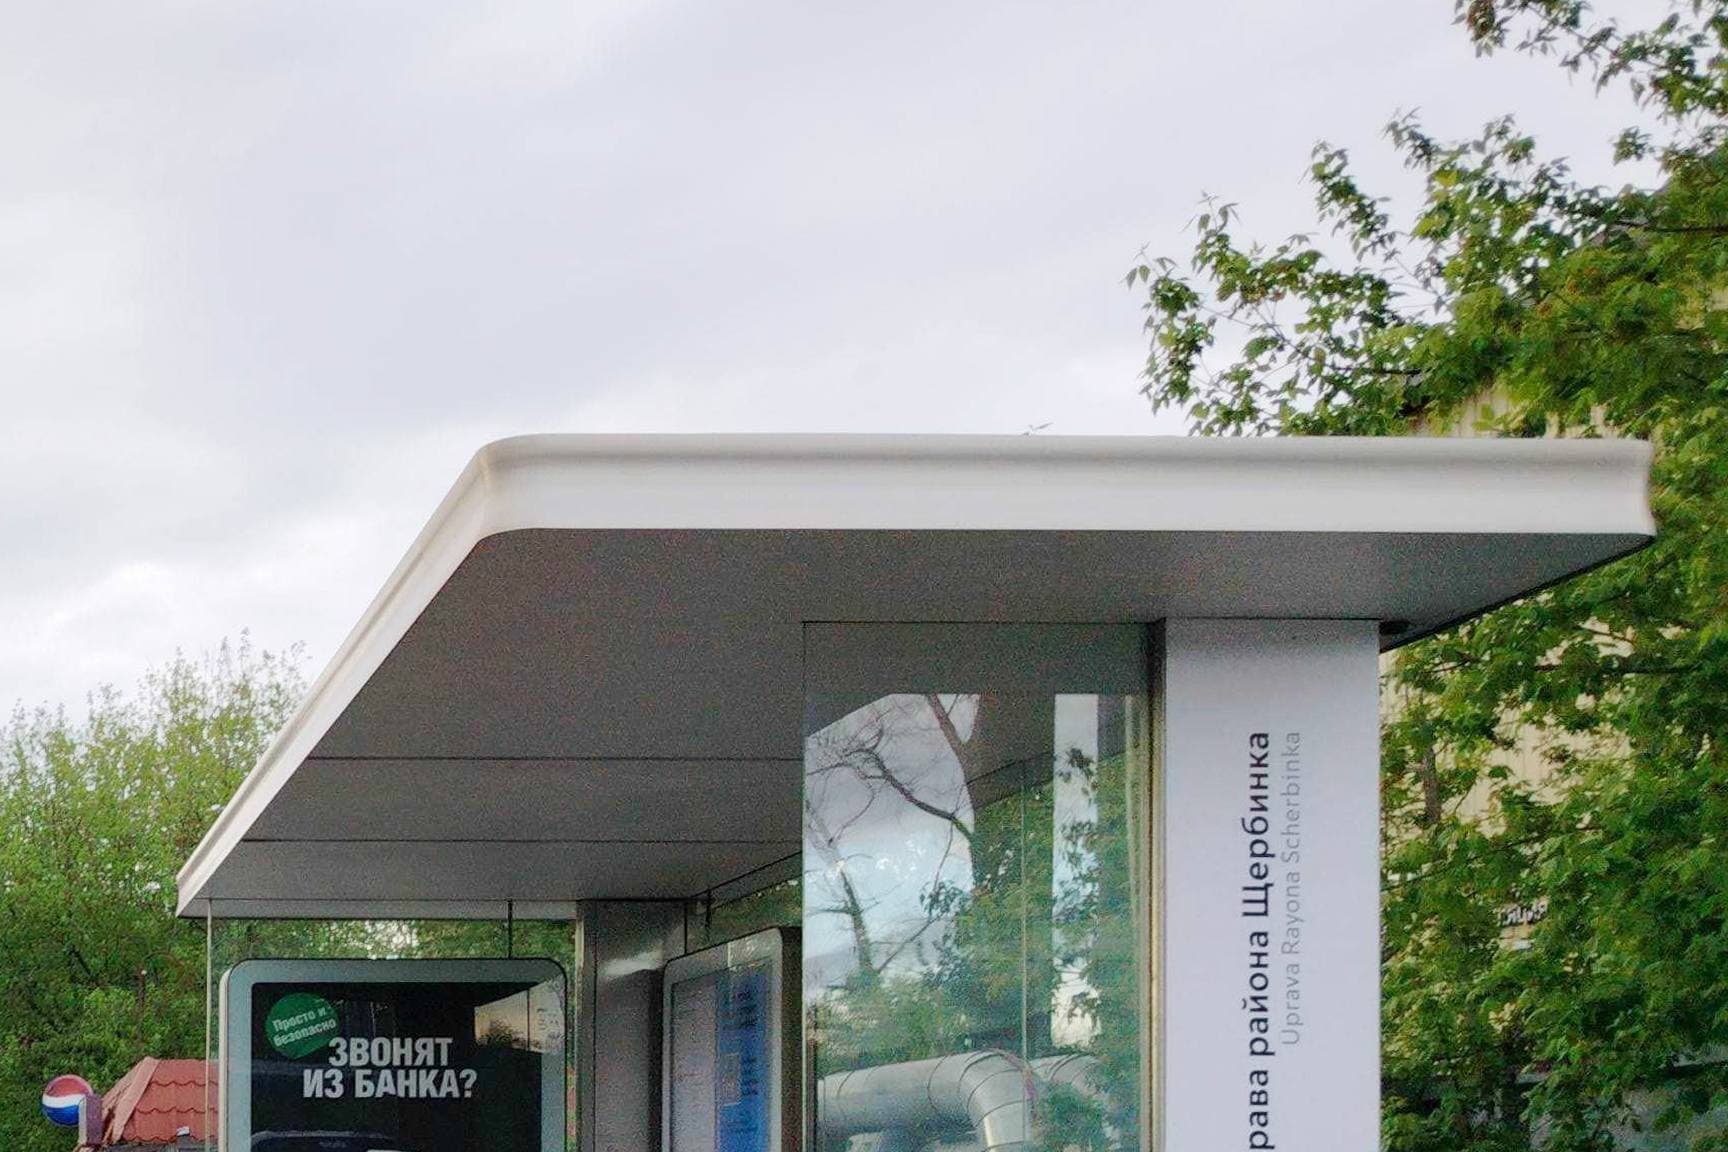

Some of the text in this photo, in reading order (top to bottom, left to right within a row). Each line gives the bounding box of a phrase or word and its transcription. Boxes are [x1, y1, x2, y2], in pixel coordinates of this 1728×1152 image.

[1241, 731, 1276, 917] Щербинка
[1280, 731, 1305, 1046] Uprava Rayona Scherbinka
[1241, 931, 1276, 1057] района
[273, 1010, 316, 1032] Просто
[273, 1019, 337, 1048] безопасно
[328, 1036, 454, 1067] ЗВОНЯТ
[303, 1068, 478, 1099] ИЗ БАНКА?
